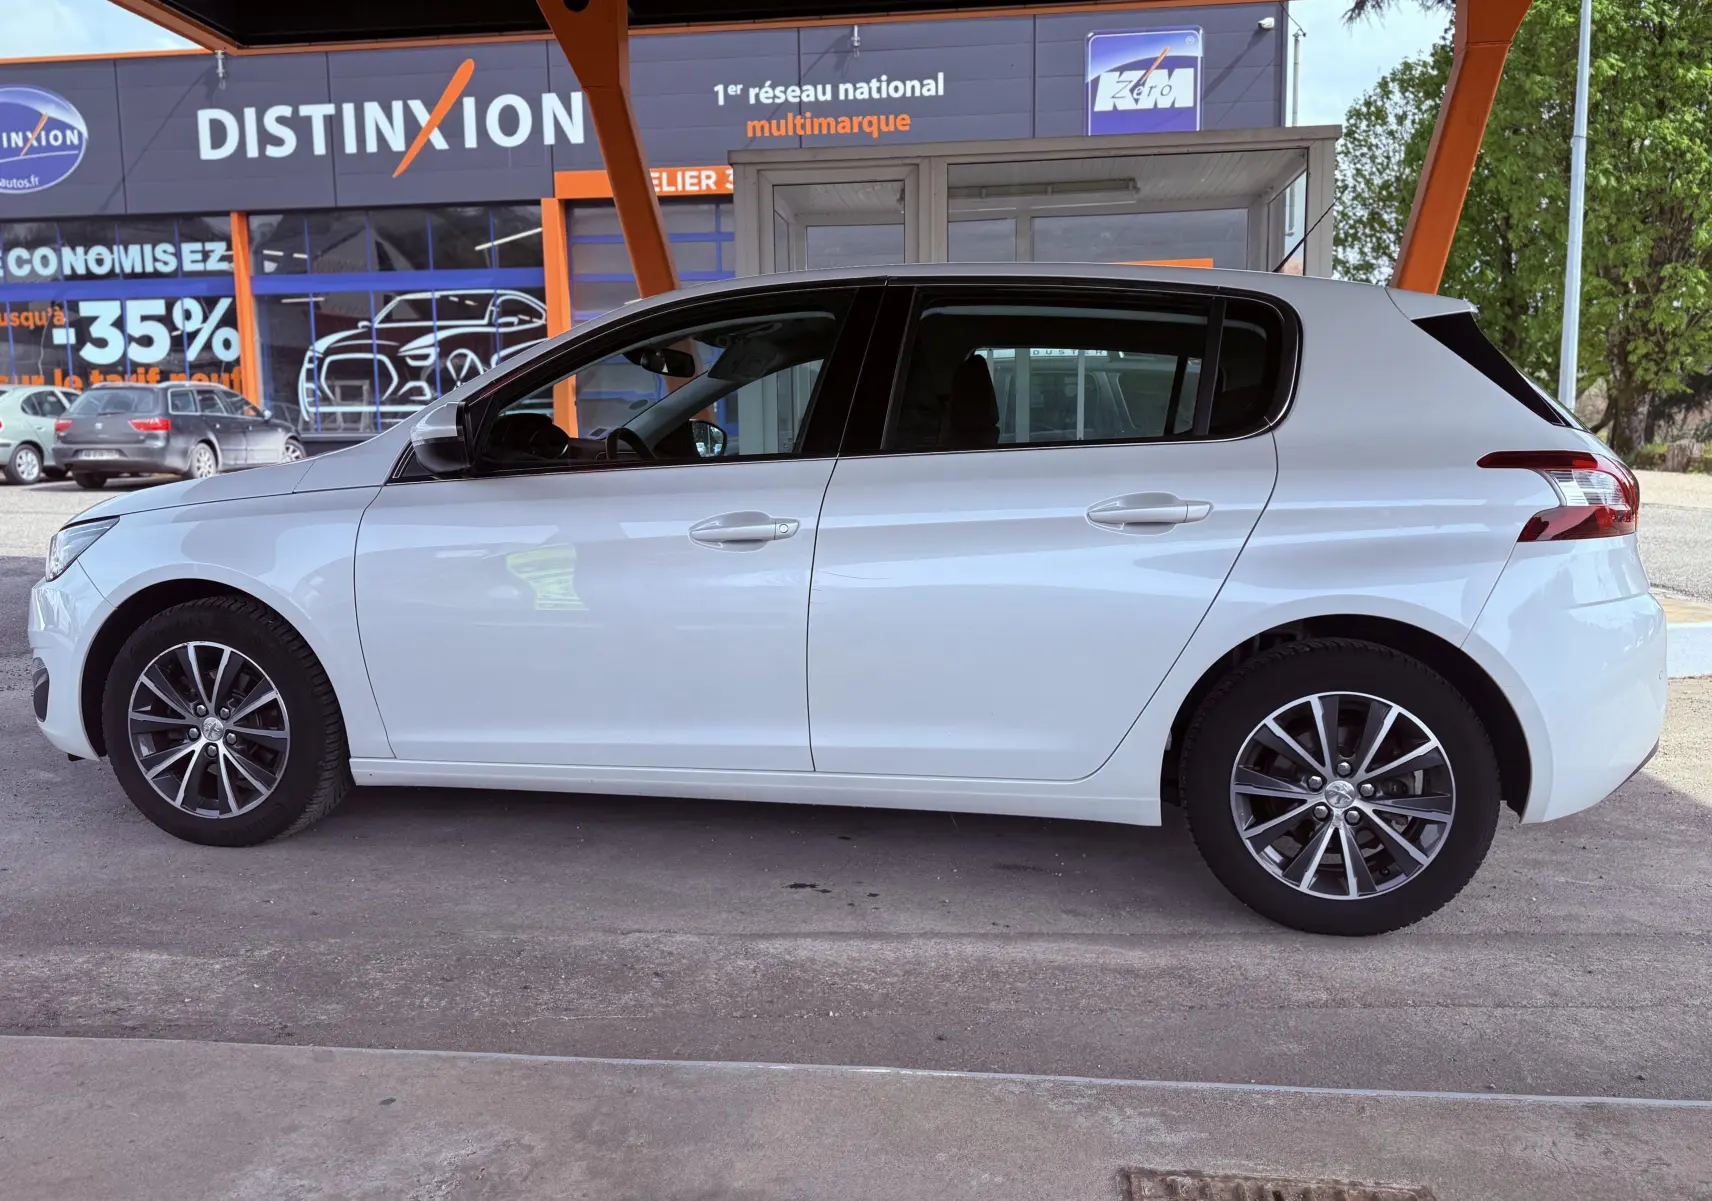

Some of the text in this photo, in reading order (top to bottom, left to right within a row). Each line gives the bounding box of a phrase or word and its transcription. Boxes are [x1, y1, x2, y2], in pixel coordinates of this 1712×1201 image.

[713, 72, 944, 105] 1er réseau national
[1111, 79, 1172, 99] Zero
[197, 58, 584, 178] DISTINXION
[747, 112, 911, 138] multimarque
[0, 241, 227, 277] CONOMISEZ
[52, 297, 240, 365] -35%
